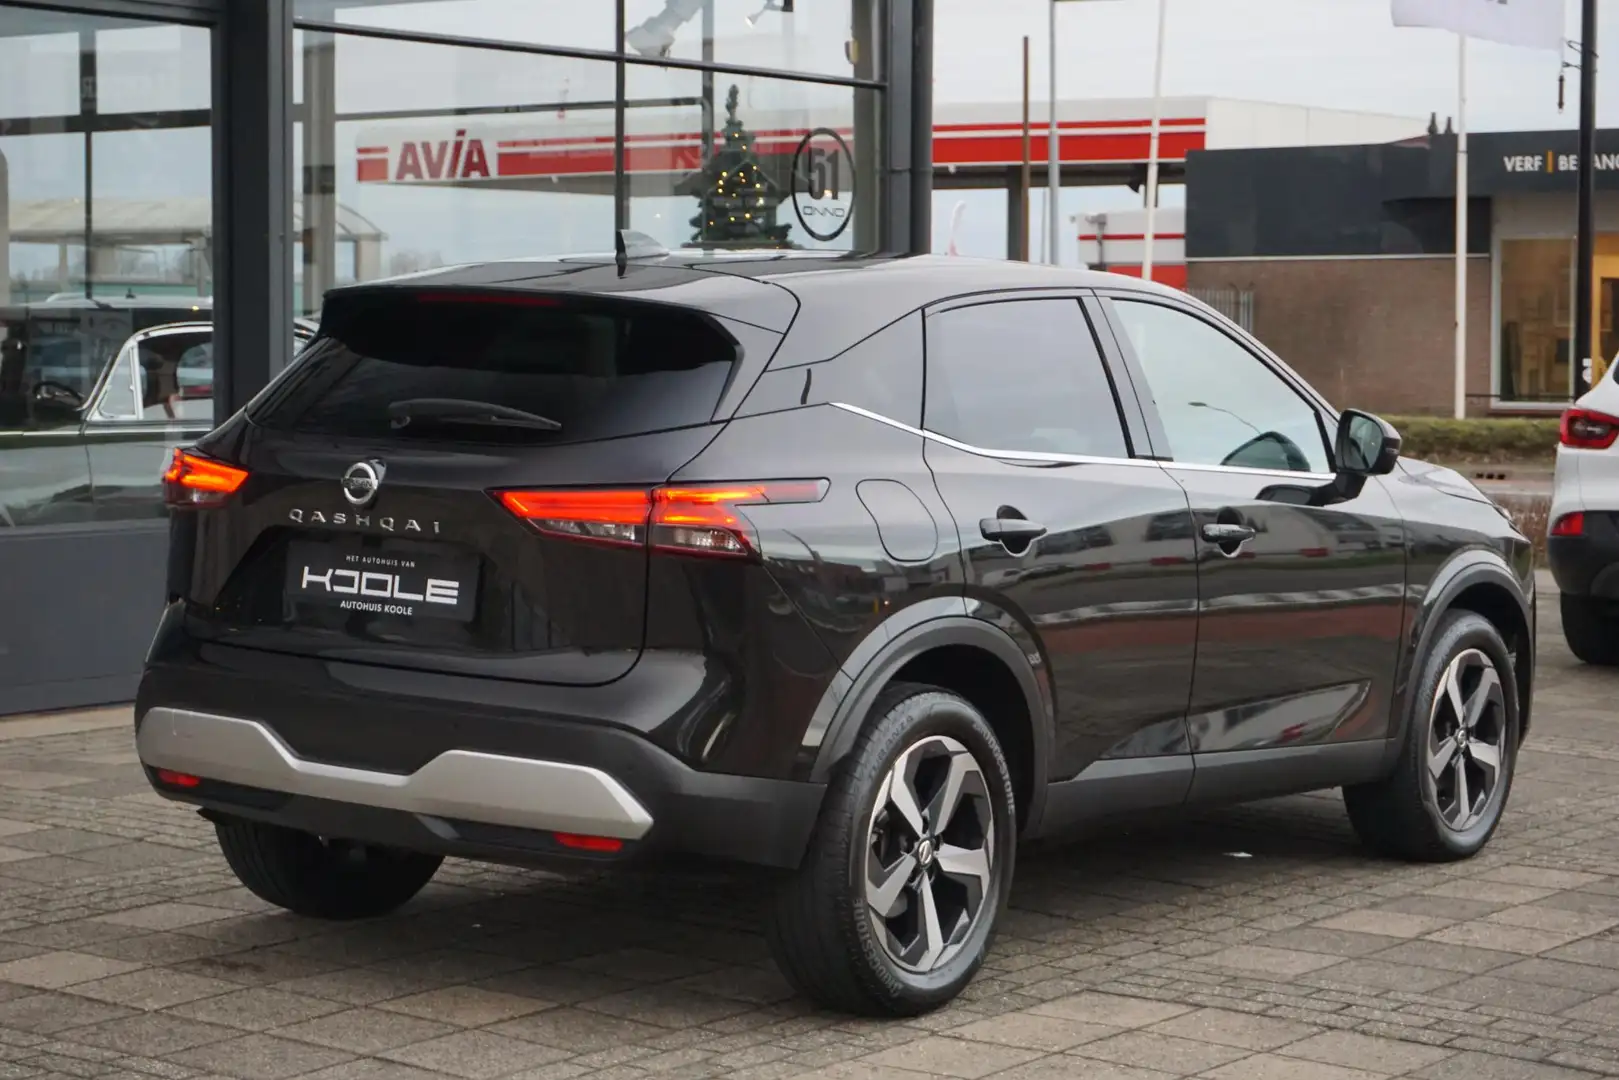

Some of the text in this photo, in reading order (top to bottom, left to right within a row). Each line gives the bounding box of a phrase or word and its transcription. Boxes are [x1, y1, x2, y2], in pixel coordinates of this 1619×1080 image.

[808, 147, 839, 200] 51
[1503, 153, 1619, 172] VERF BEAN
[289, 508, 441, 534] QASHQAI
[362, 556, 398, 567] AUTOHUIS
[401, 560, 416, 568] VAN
[301, 565, 460, 605] KOOLE
[340, 600, 413, 616] AUTOHUIS KOOLE
